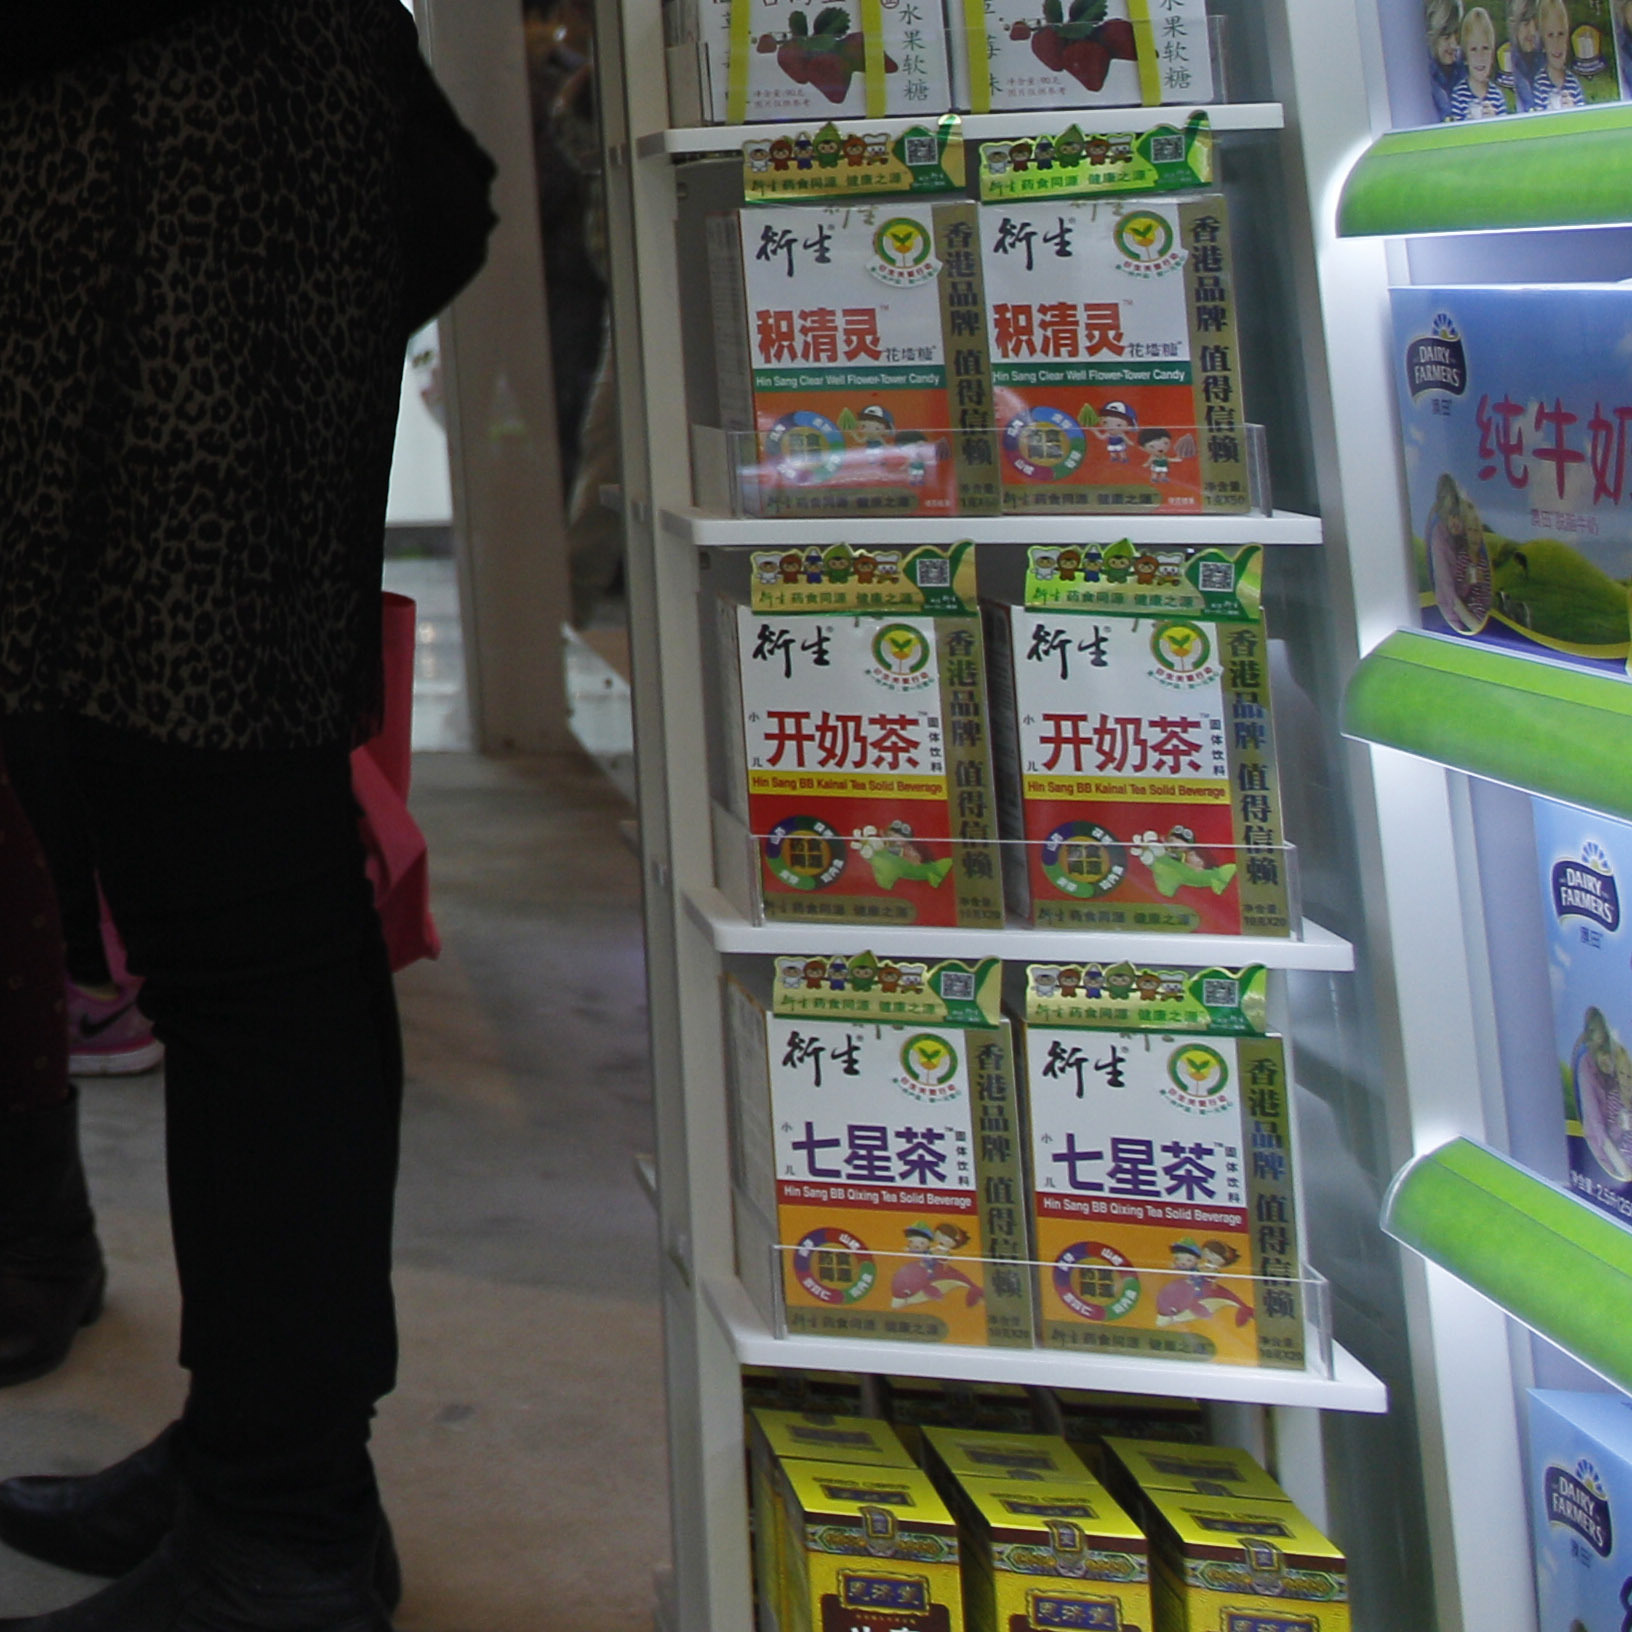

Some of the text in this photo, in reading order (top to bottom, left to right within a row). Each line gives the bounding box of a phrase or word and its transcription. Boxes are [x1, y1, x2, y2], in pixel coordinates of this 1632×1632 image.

[941, 221, 983, 338] 香港品牌
[1188, 214, 1230, 334] 香港品牌
[756, 307, 882, 364] 积清灵
[993, 302, 1125, 359] 积清灵
[1419, 345, 1450, 364] DAIRY
[1038, 371, 1063, 381] Clear
[1153, 370, 1185, 382] Candy
[1415, 366, 1459, 387] FARMERS
[943, 631, 981, 748] 香港品牌
[764, 710, 921, 770] 开奶茶
[1039, 713, 1202, 774] 开奶茶
[1179, 786, 1225, 798] Beverage
[1561, 887, 1611, 924] FARMERS
[1566, 868, 1602, 896] DAIRY
[975, 1042, 1012, 1164] 香港品牌
[792, 1122, 948, 1185] 七星茶
[1052, 1133, 1216, 1200] 七星茶
[1195, 1209, 1242, 1225] Beverage
